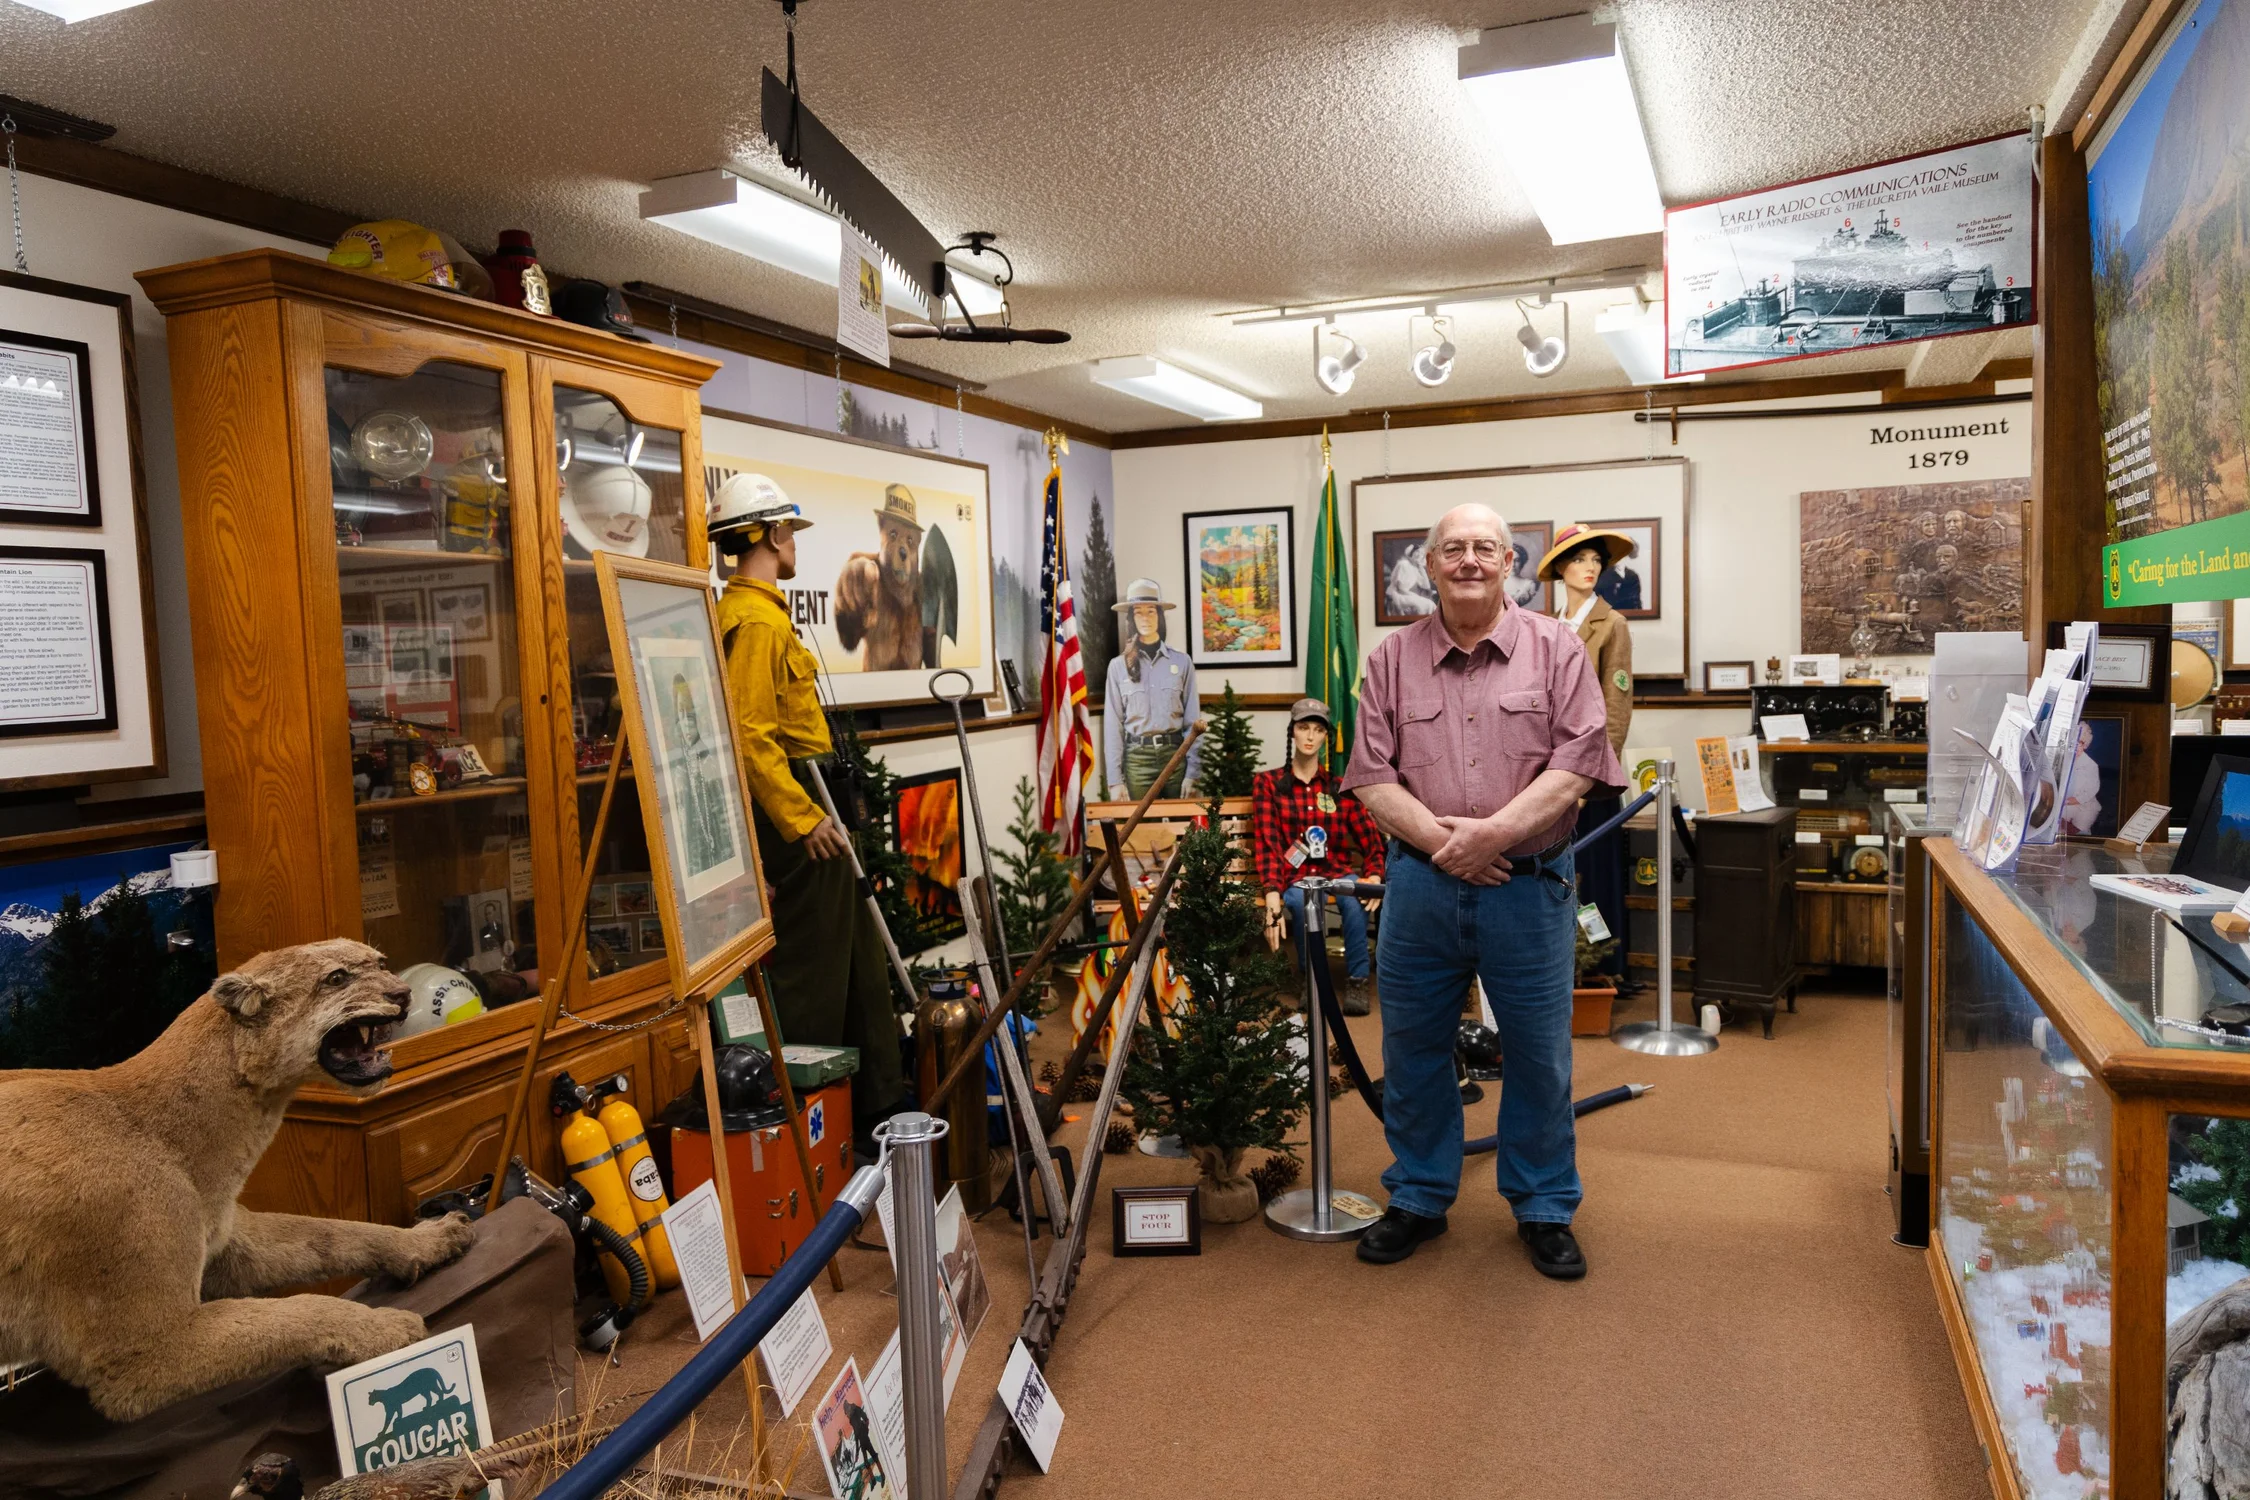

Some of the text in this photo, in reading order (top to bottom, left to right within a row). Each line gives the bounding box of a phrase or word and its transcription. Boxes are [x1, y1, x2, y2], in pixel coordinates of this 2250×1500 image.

[1721, 162, 1968, 227] EARLY RADIO COMMUNICATIONS
[1743, 224, 1755, 233] BY
[1758, 215, 1789, 230] WAYNE
[1792, 206, 1831, 222] RUSSERT
[1834, 205, 1842, 214] &
[1846, 199, 1865, 212] THE
[1867, 189, 1918, 208] LUCRETIA
[1921, 182, 1950, 195] VAILE
[1952, 171, 2000, 188] MUSEUM
[1844, 217, 1852, 228] 6
[1893, 217, 1901, 228] 5
[1983, 213, 2013, 225] handout
[1990, 222, 2003, 231] key
[1955, 227, 2013, 243] to the numbered
[1773, 273, 1780, 283] 2
[2005, 276, 2014, 287] 3
[1707, 300, 1714, 309] 4
[1852, 326, 1860, 338] 7
[1870, 418, 2010, 445] Monument
[1908, 449, 1970, 470] 1879
[2165, 556, 2179, 579] for
[2181, 553, 2198, 577] the
[2199, 546, 2231, 574] Land
[432, 986, 450, 1017] ASST.
[1141, 1213, 1171, 1221] STOP
[1141, 1222, 1172, 1230] FOUR
[365, 1411, 470, 1473] COUGAR
